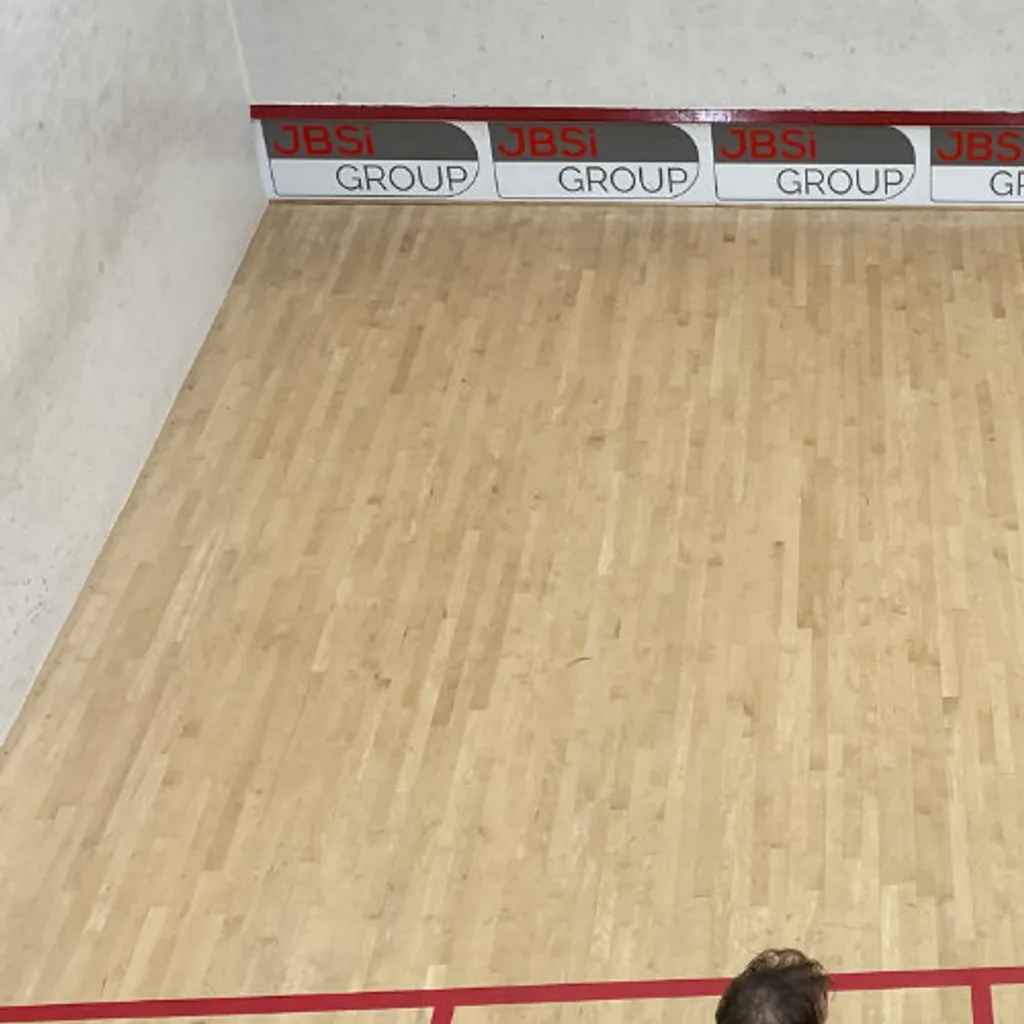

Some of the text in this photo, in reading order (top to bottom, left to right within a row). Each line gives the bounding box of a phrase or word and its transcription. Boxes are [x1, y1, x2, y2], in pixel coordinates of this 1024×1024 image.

[273, 124, 374, 156] JBSi
[497, 126, 597, 159] JBSi
[719, 128, 818, 160] JBSi
[335, 164, 469, 192] GROUP
[557, 165, 689, 194] GROUP
[776, 168, 905, 196] GROUP
